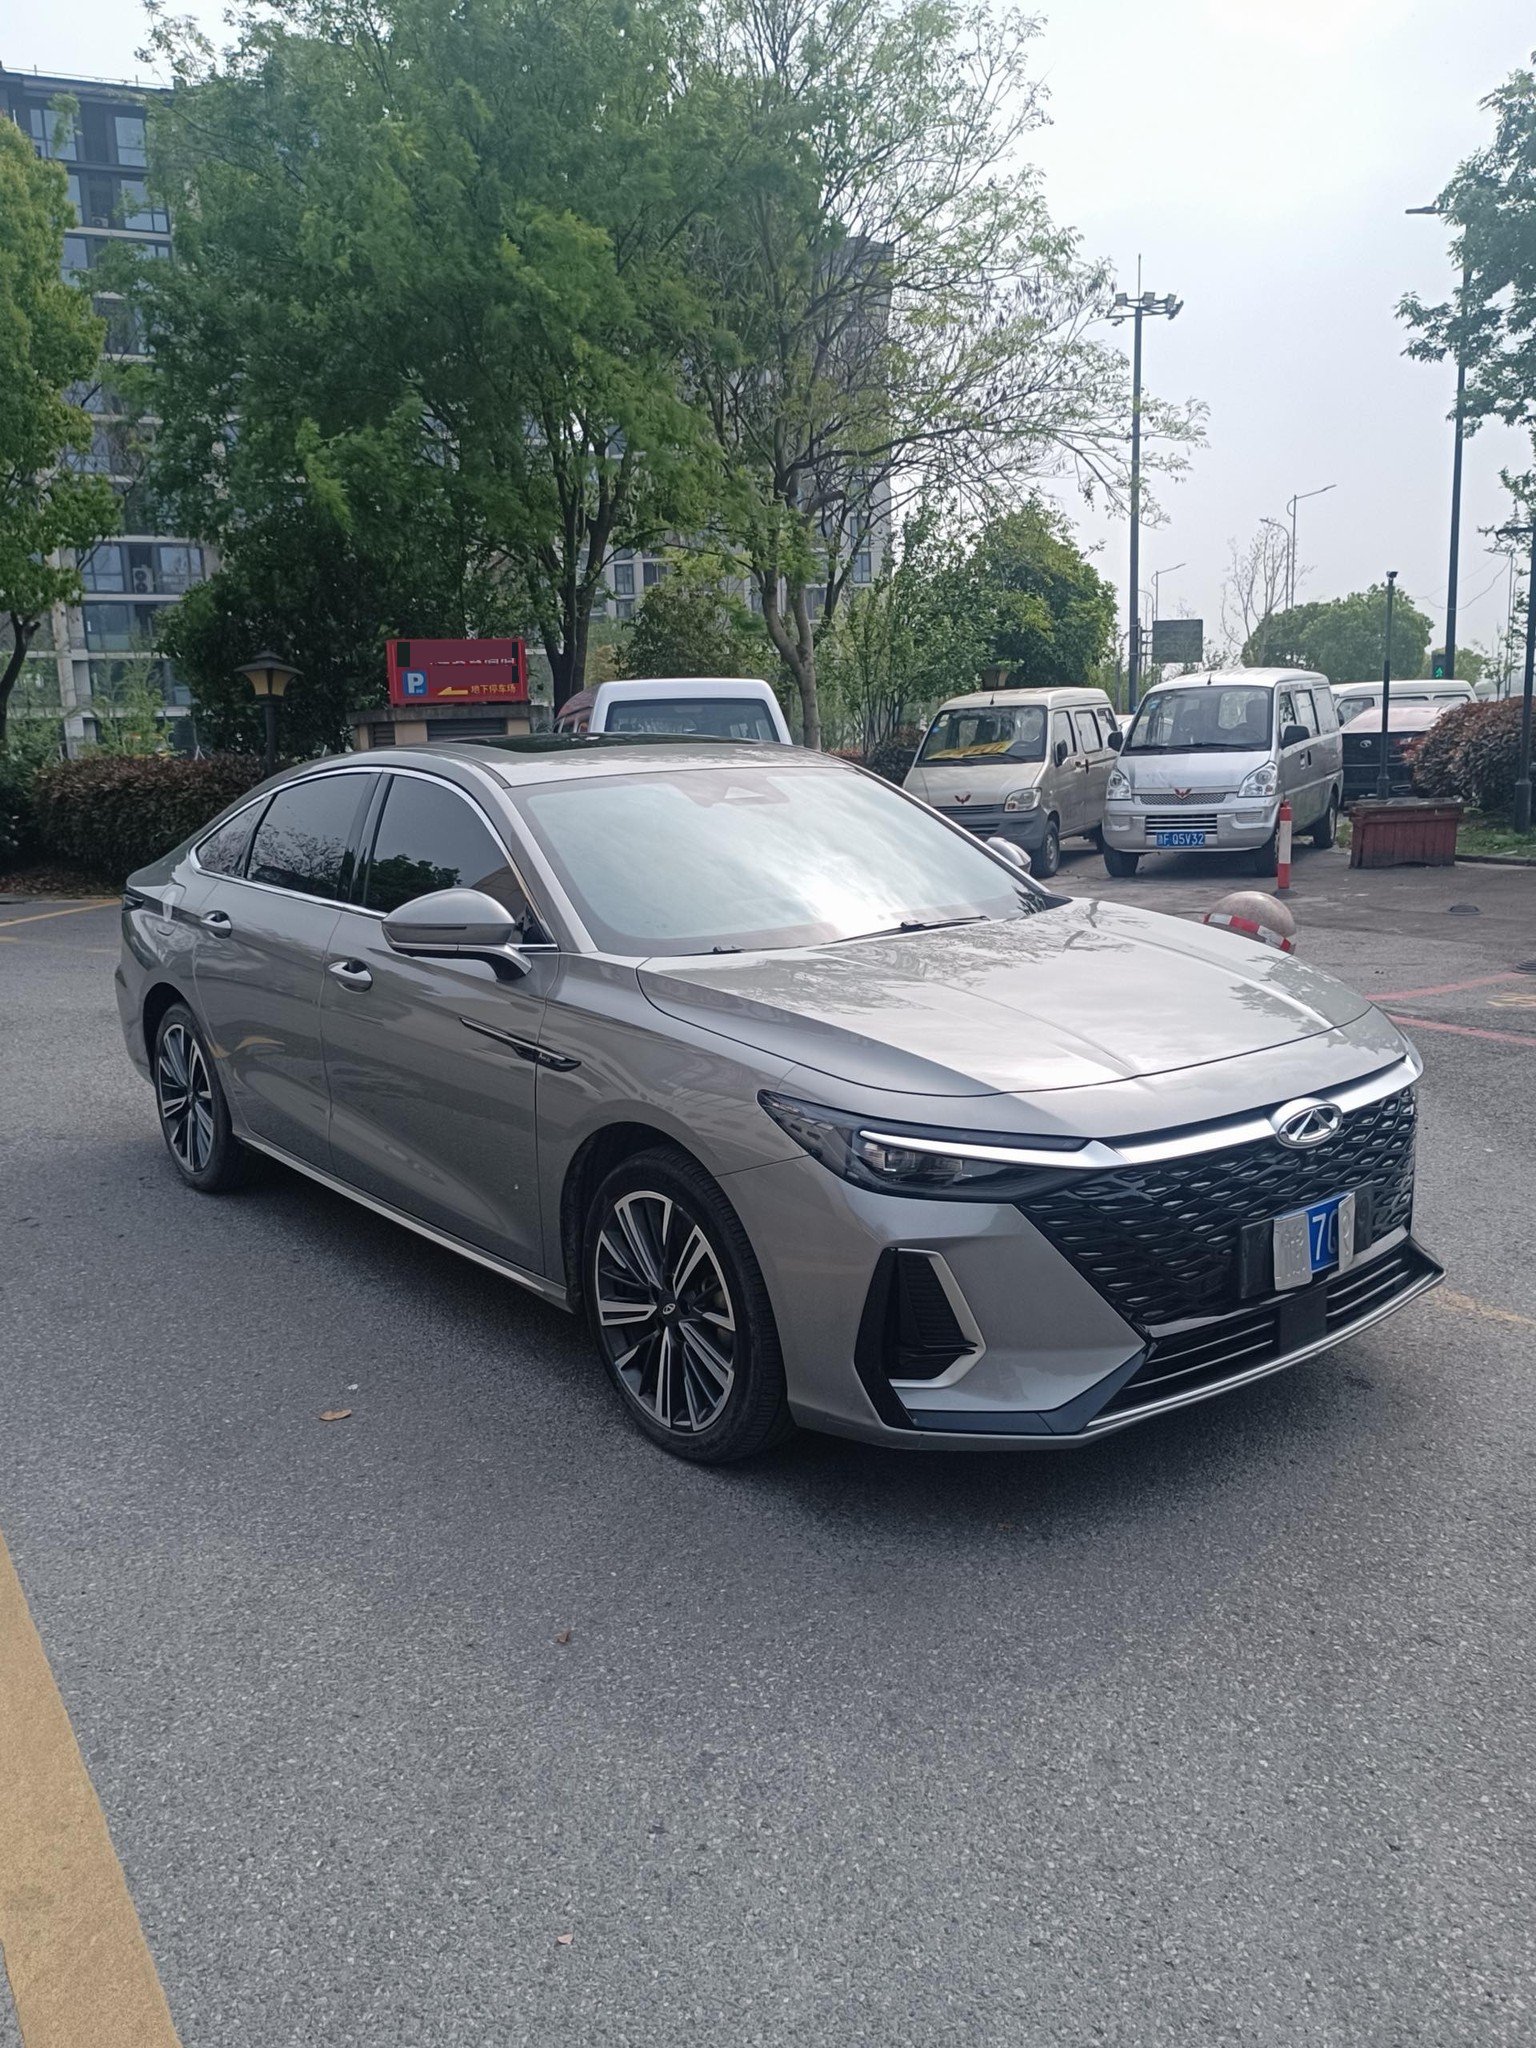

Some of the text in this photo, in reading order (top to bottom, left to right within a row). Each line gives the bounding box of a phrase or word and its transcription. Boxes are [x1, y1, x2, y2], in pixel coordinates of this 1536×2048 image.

[407, 673, 425, 694] P
[471, 684, 516, 694] 地下停车场
